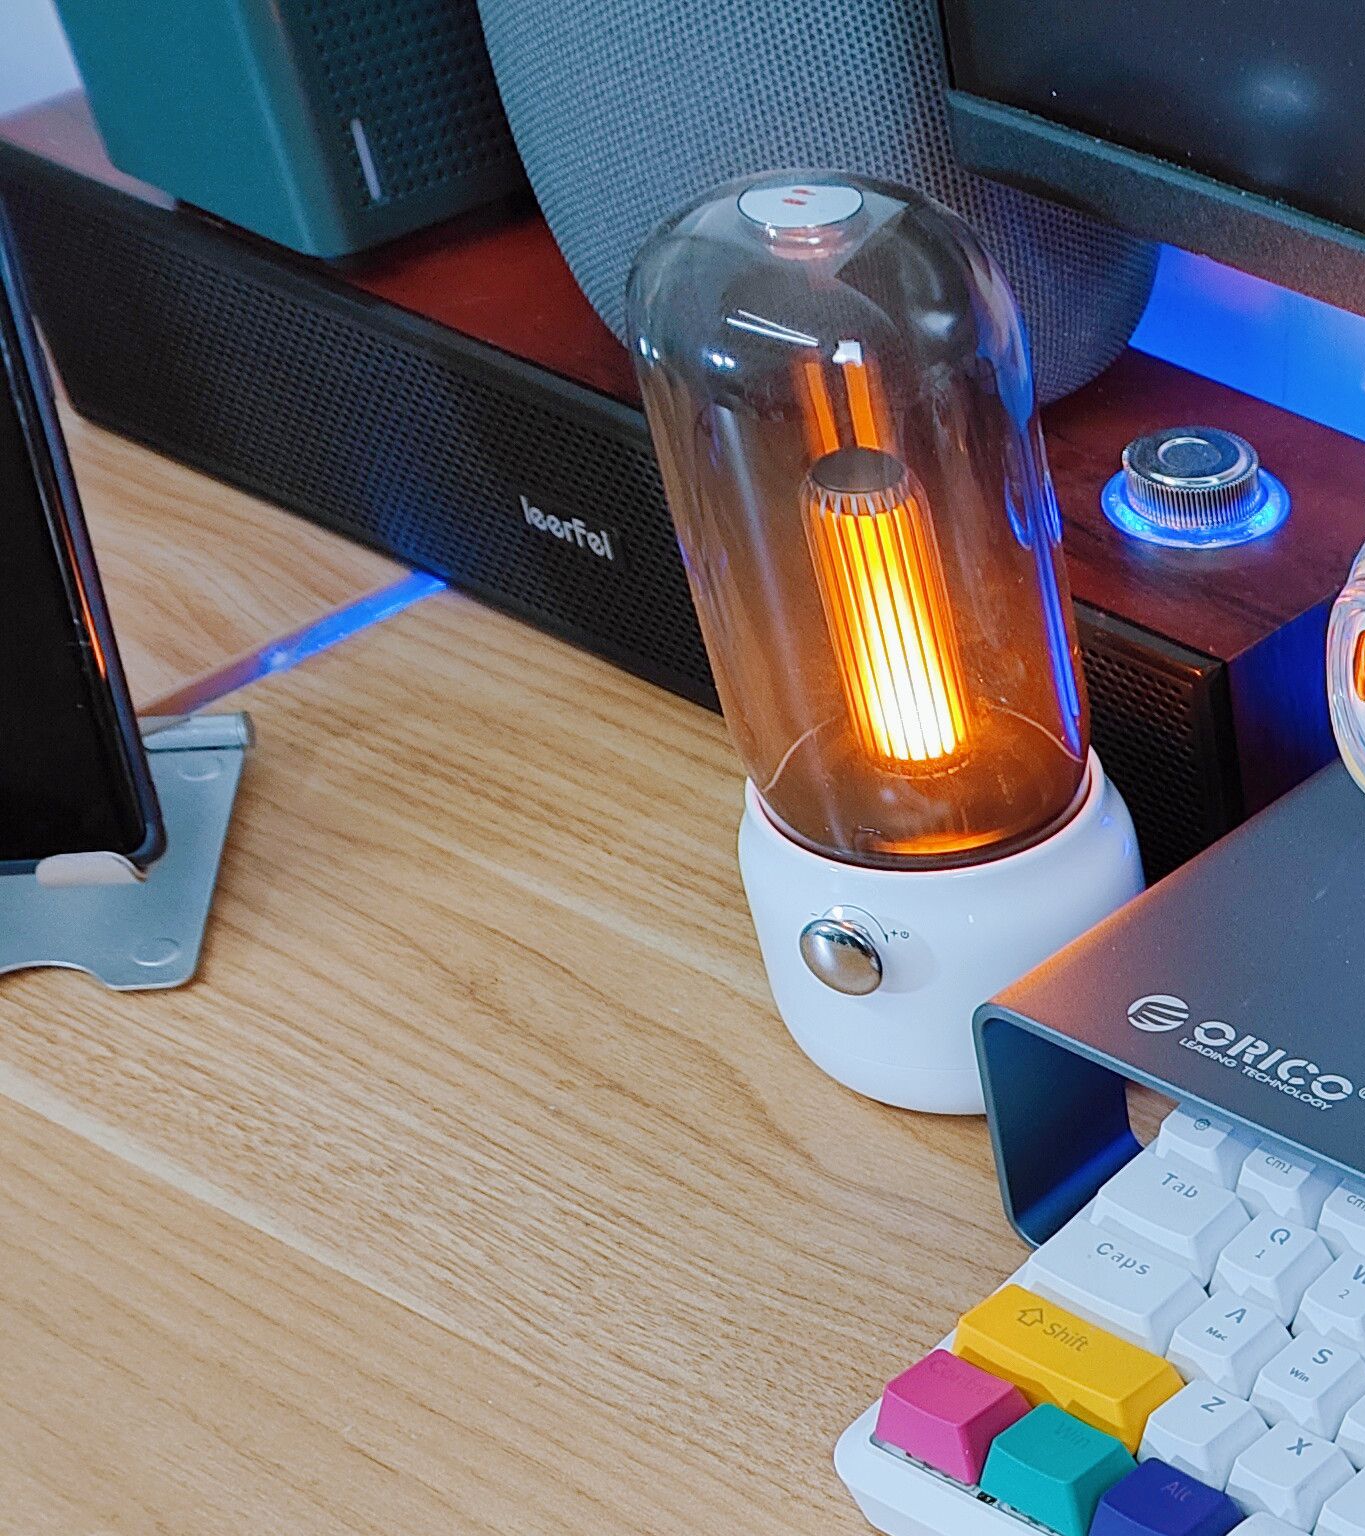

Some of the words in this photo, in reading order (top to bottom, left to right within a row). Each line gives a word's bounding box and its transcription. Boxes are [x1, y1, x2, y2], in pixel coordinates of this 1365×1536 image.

[1179, 1037, 1238, 1069] LEADING
[1240, 1066, 1333, 1111] TECHNOLOGY
[1160, 1173, 1199, 1199] Tab
[1270, 1228, 1292, 1246] Q
[1096, 1242, 1151, 1276] Caps
[1225, 1307, 1248, 1324] A
[1042, 1322, 1090, 1352] Shift
[1205, 1326, 1228, 1343] Mac
[1312, 1348, 1333, 1365] S
[1289, 1366, 1310, 1383] Win
[1200, 1396, 1227, 1414] Z
[1286, 1438, 1313, 1456] X
[1161, 1481, 1194, 1502] Alt
